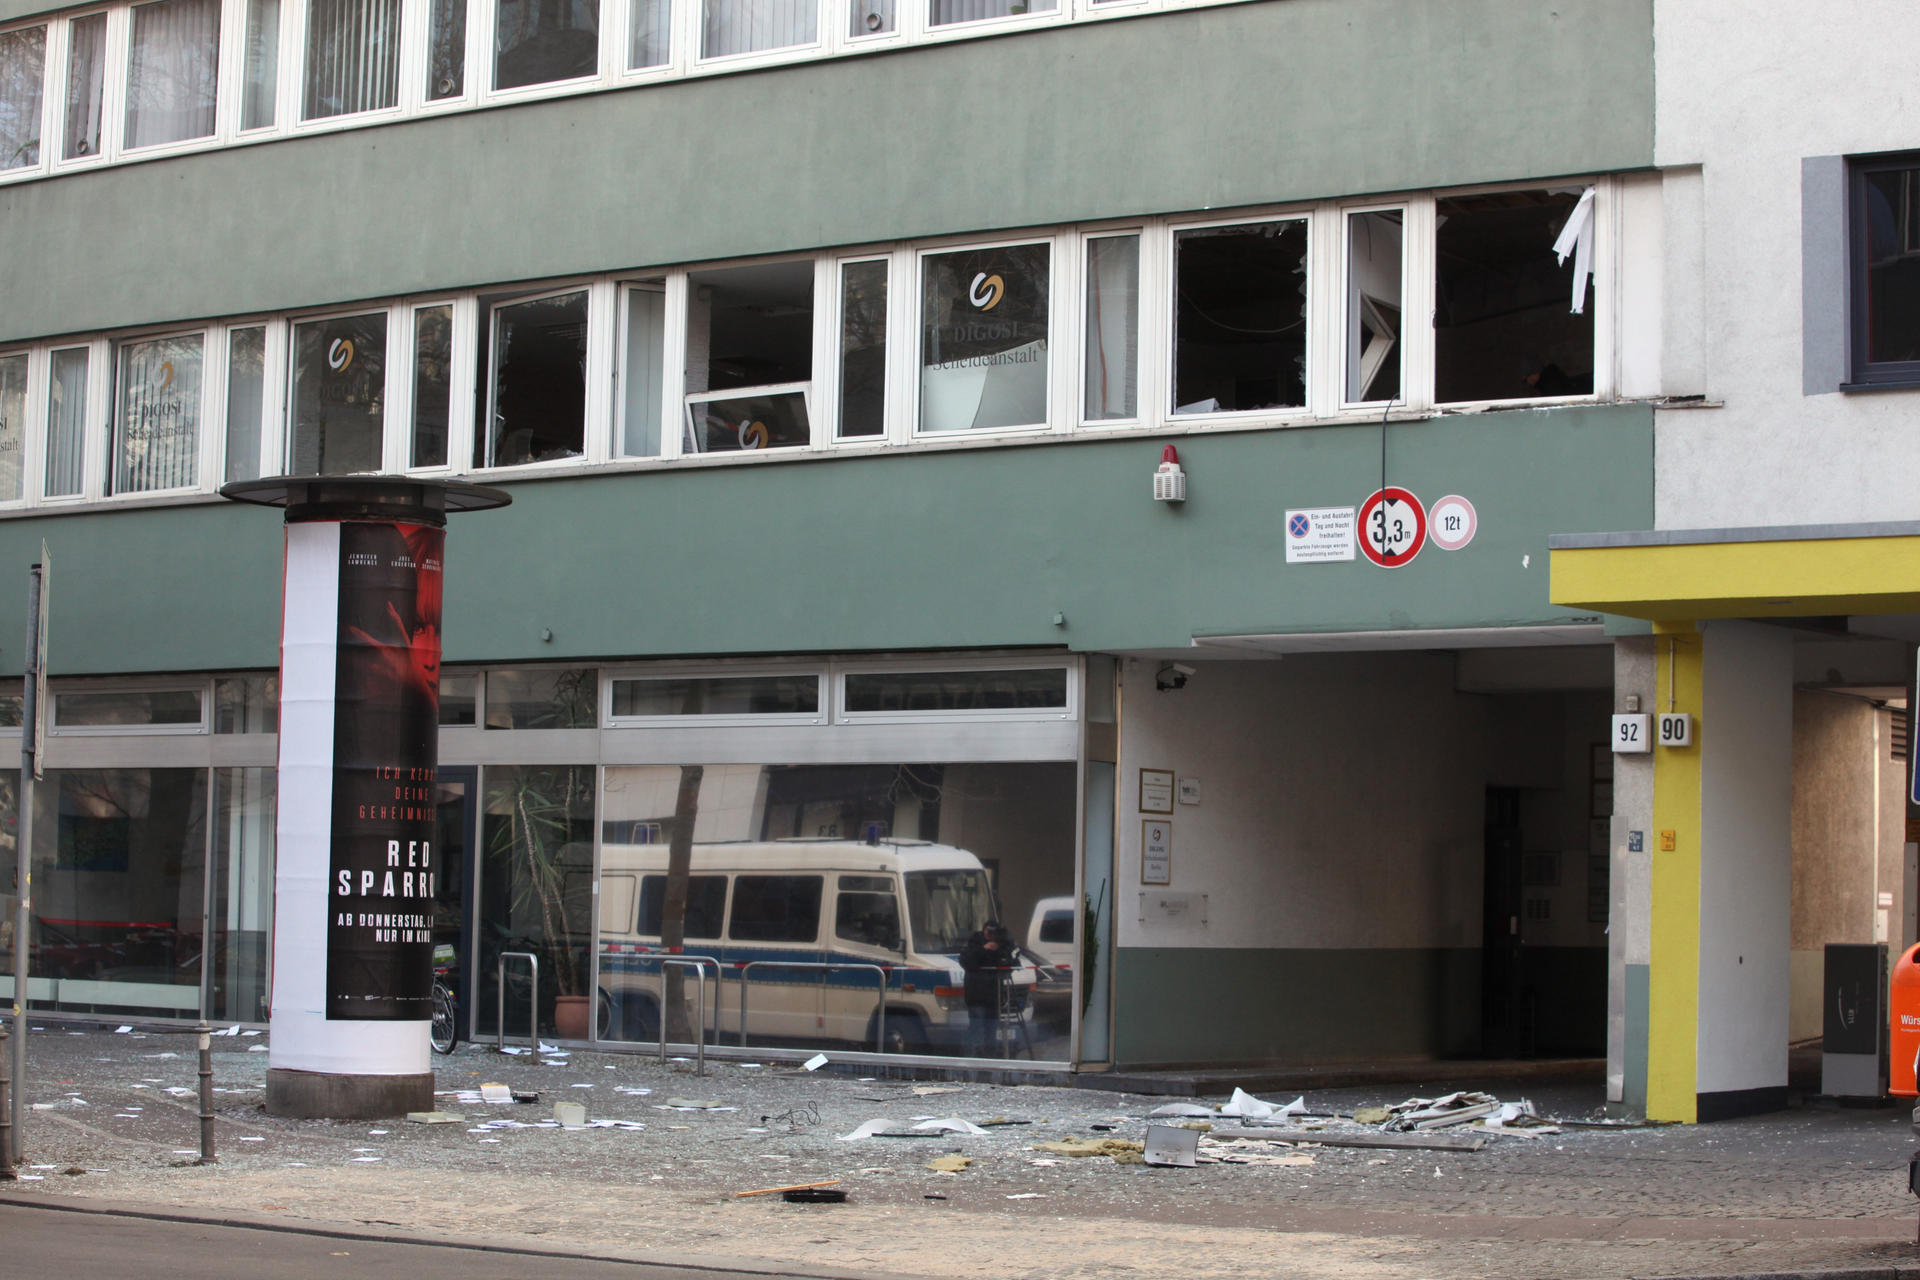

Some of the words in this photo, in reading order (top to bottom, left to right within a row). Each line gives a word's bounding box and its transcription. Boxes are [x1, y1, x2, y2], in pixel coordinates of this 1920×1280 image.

[954, 321, 1018, 343] DIGOSI
[933, 347, 1038, 371] Scheideanstalt
[1373, 510, 1403, 546] 3,3
[1404, 531, 1411, 539] m
[1620, 723, 1638, 741] 92
[1662, 718, 1685, 740] 90
[376, 766, 401, 779] ICH
[395, 786, 429, 801] DEINE
[388, 839, 430, 868] RED
[338, 913, 353, 927] AB
[376, 929, 397, 942] NUR
[403, 930, 413, 942] IM
